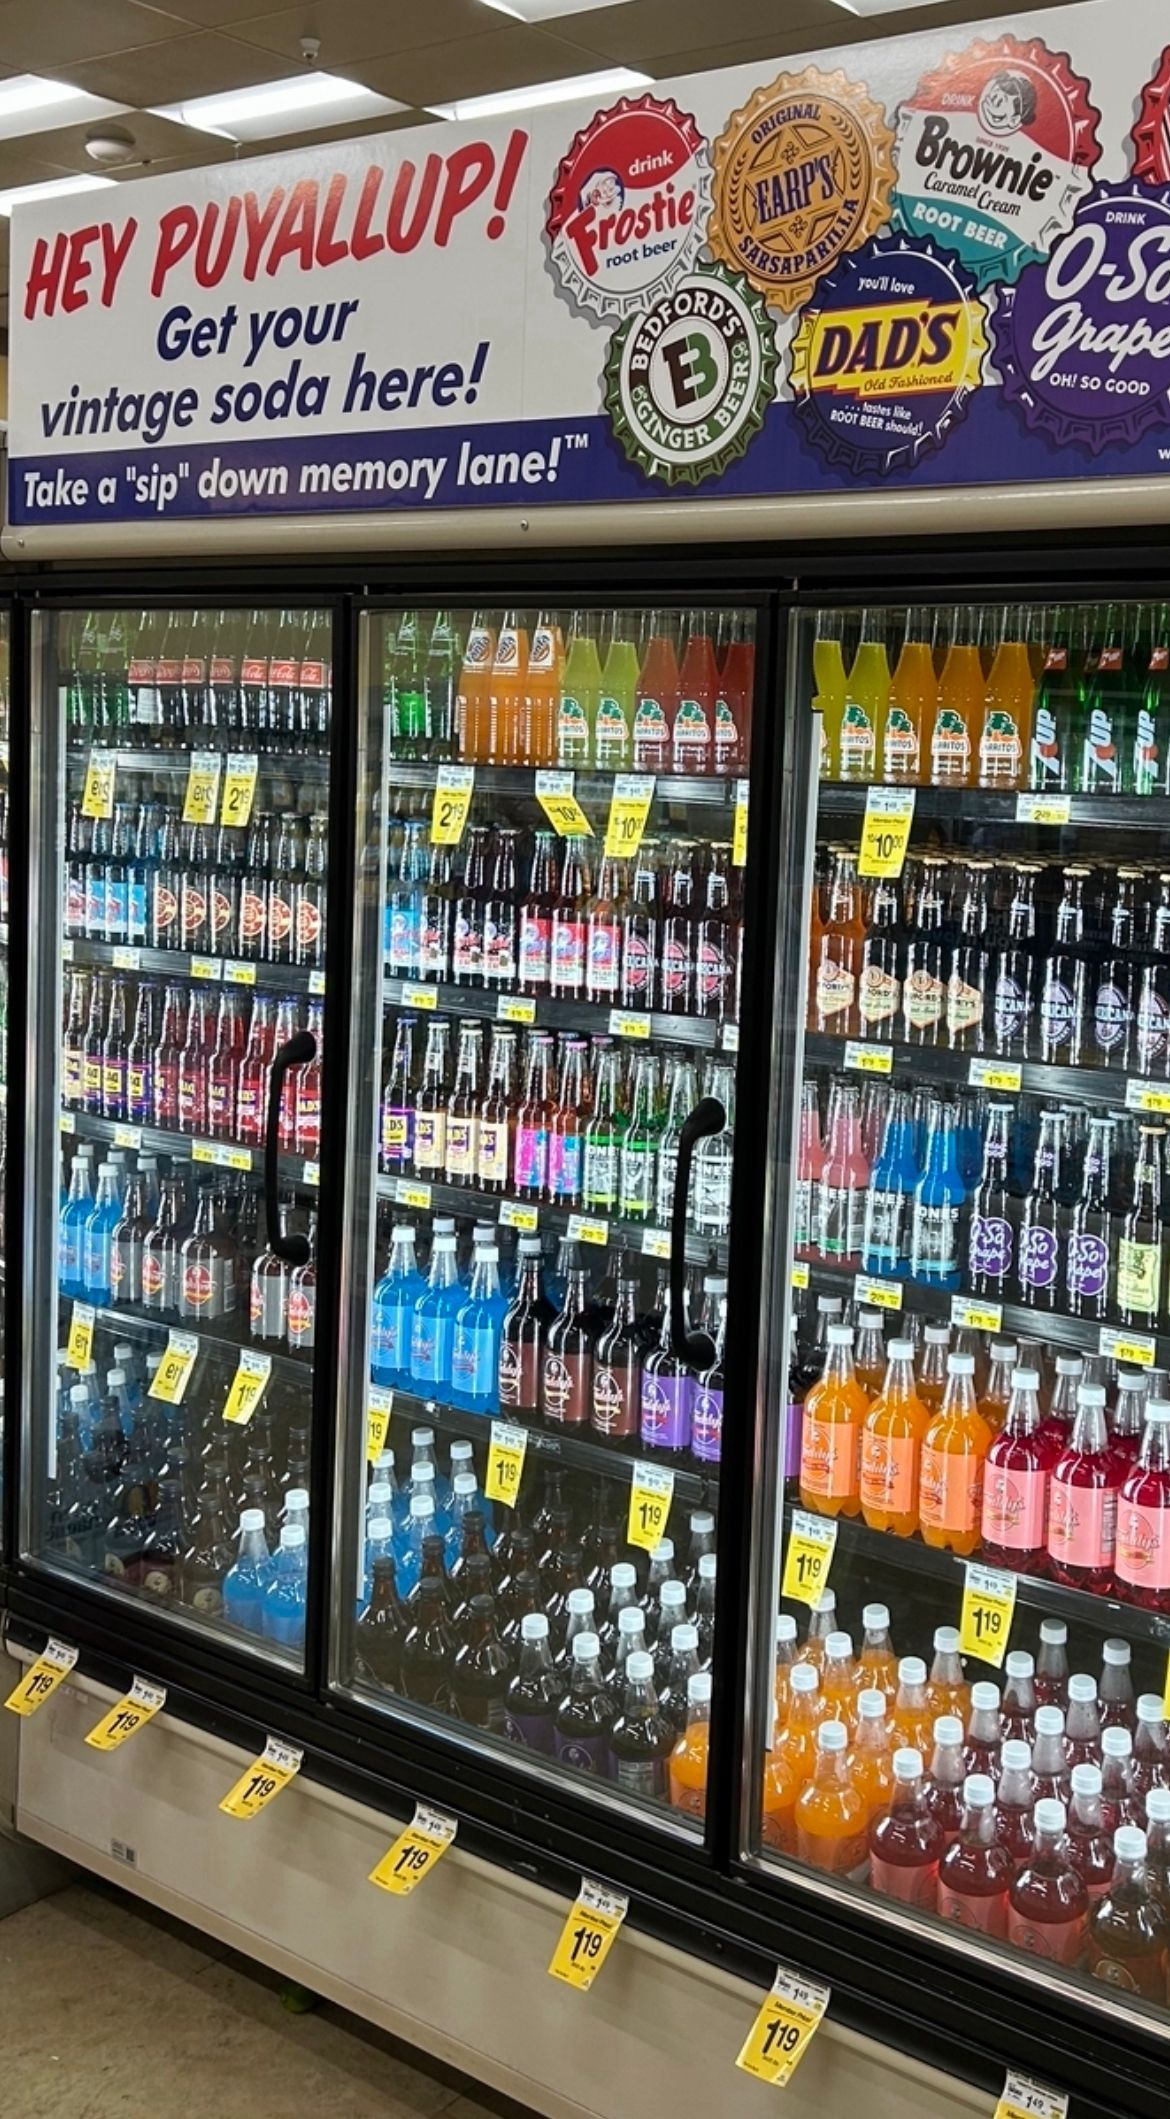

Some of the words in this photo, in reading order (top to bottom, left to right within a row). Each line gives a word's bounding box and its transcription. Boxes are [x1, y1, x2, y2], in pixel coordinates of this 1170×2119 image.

[942, 93, 975, 106] DRINK
[751, 103, 822, 145] ORIGINAL
[628, 150, 674, 177] drink
[915, 115, 1052, 202] Brownie
[756, 155, 834, 225] EARP'S
[924, 171, 980, 200] Caramel
[978, 194, 1021, 217] Cream
[23, 217, 138, 321] HEY
[151, 128, 530, 298] PUYALLUP!
[566, 182, 696, 277] Frostie
[913, 202, 960, 233] ROOT
[963, 220, 1009, 250] BEER
[1105, 211, 1147, 225] DRINK
[738, 199, 857, 275] SARSAPARILLA
[606, 248, 640, 268] root
[642, 239, 678, 258] beer
[857, 276, 889, 291] you'll
[890, 278, 915, 295] love
[157, 305, 238, 361] Get
[244, 300, 359, 366] your
[631, 291, 741, 371] BEDFORD'S
[813, 309, 961, 378] DAD'S
[41, 385, 199, 444] vintage
[211, 360, 329, 424] soda
[343, 341, 491, 412] here!
[714, 362, 749, 427] BEER
[864, 377, 886, 393] Old
[888, 371, 954, 390] Fashioned
[1050, 373, 1077, 388] OH!
[1080, 375, 1101, 390] SO
[1105, 380, 1150, 396] GOOD
[635, 400, 713, 448] GINGER
[830, 409, 857, 425] ROOT
[860, 416, 884, 431] BEER
[885, 417, 923, 436] should!
[893, 405, 912, 420] like
[23, 471, 90, 508] Take
[97, 479, 117, 504] a
[126, 463, 190, 511] "sip"
[199, 457, 288, 499] down
[299, 455, 446, 499] memory
[496, 1460, 517, 1485] 119
[639, 1502, 662, 1530] 119
[796, 1553, 822, 1583] 119
[972, 1607, 1002, 1638] 119
[25, 1671, 55, 1697] 119
[107, 1710, 140, 1734] 119
[243, 1774, 276, 1800] 119
[394, 1845, 429, 1872] 119
[571, 1927, 603, 1961] 119
[762, 2019, 800, 2054] 119
